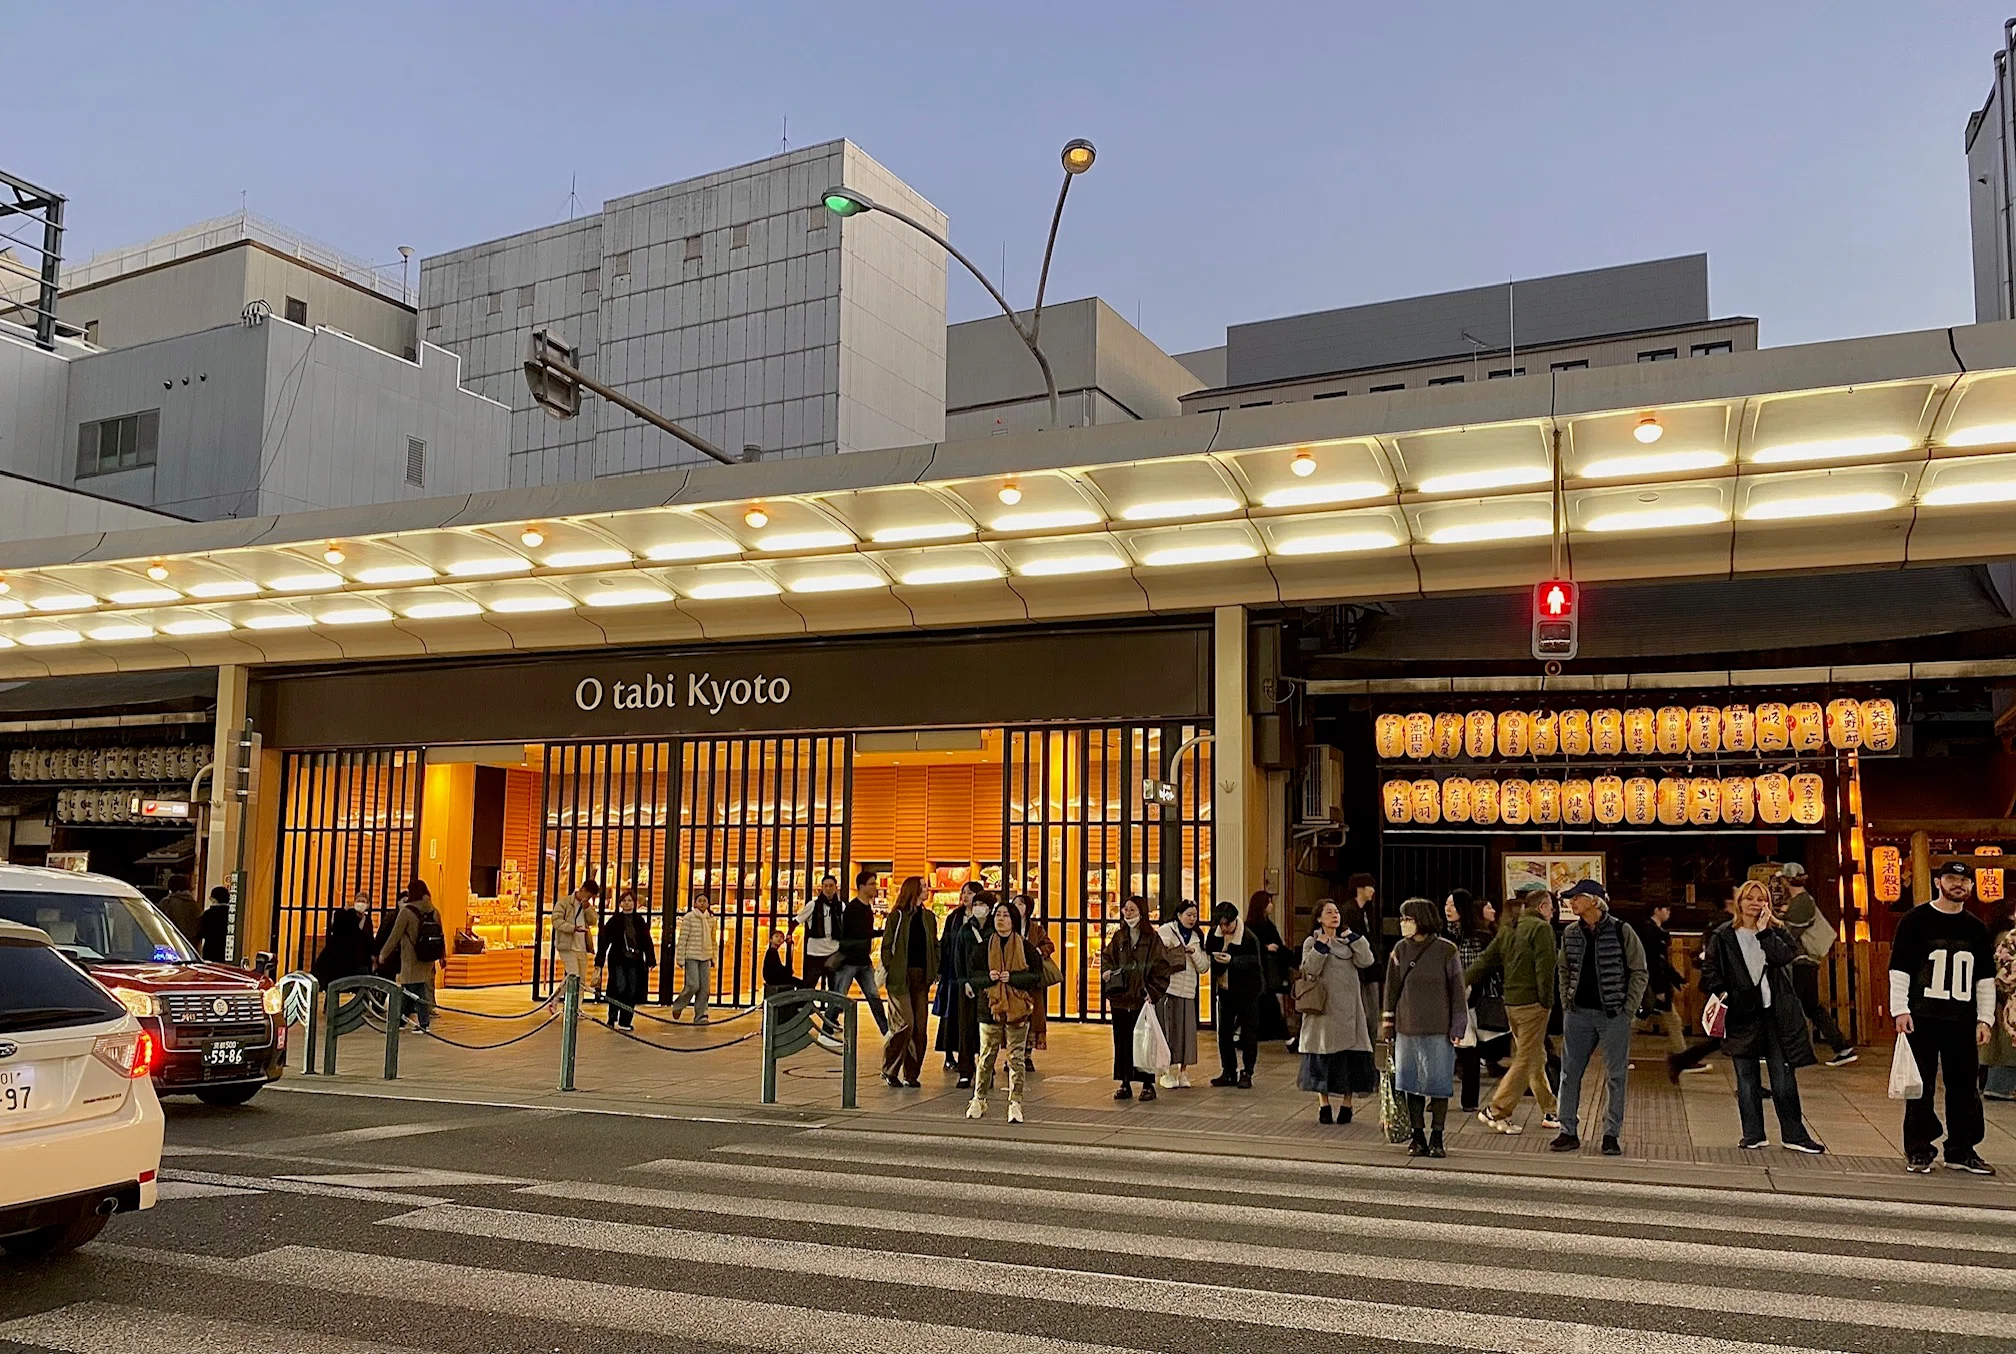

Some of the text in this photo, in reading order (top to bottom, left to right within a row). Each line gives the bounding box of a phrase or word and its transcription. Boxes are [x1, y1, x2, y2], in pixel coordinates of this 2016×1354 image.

[575, 673, 790, 715] O tabi Kyoto
[1410, 722, 1423, 754] 池田屋
[1535, 730, 1547, 751] 大丸
[1566, 730, 1579, 750] 大丸
[1600, 730, 1613, 750] 大丸
[1844, 709, 1859, 744] 矢野一郎
[1872, 709, 1888, 749] 矢野一郎
[1418, 792, 1430, 819] 乙羽
[1883, 850, 1899, 896] 冠者殿社
[1924, 949, 1975, 1002] 10
[211, 1049, 243, 1064] 59-86
